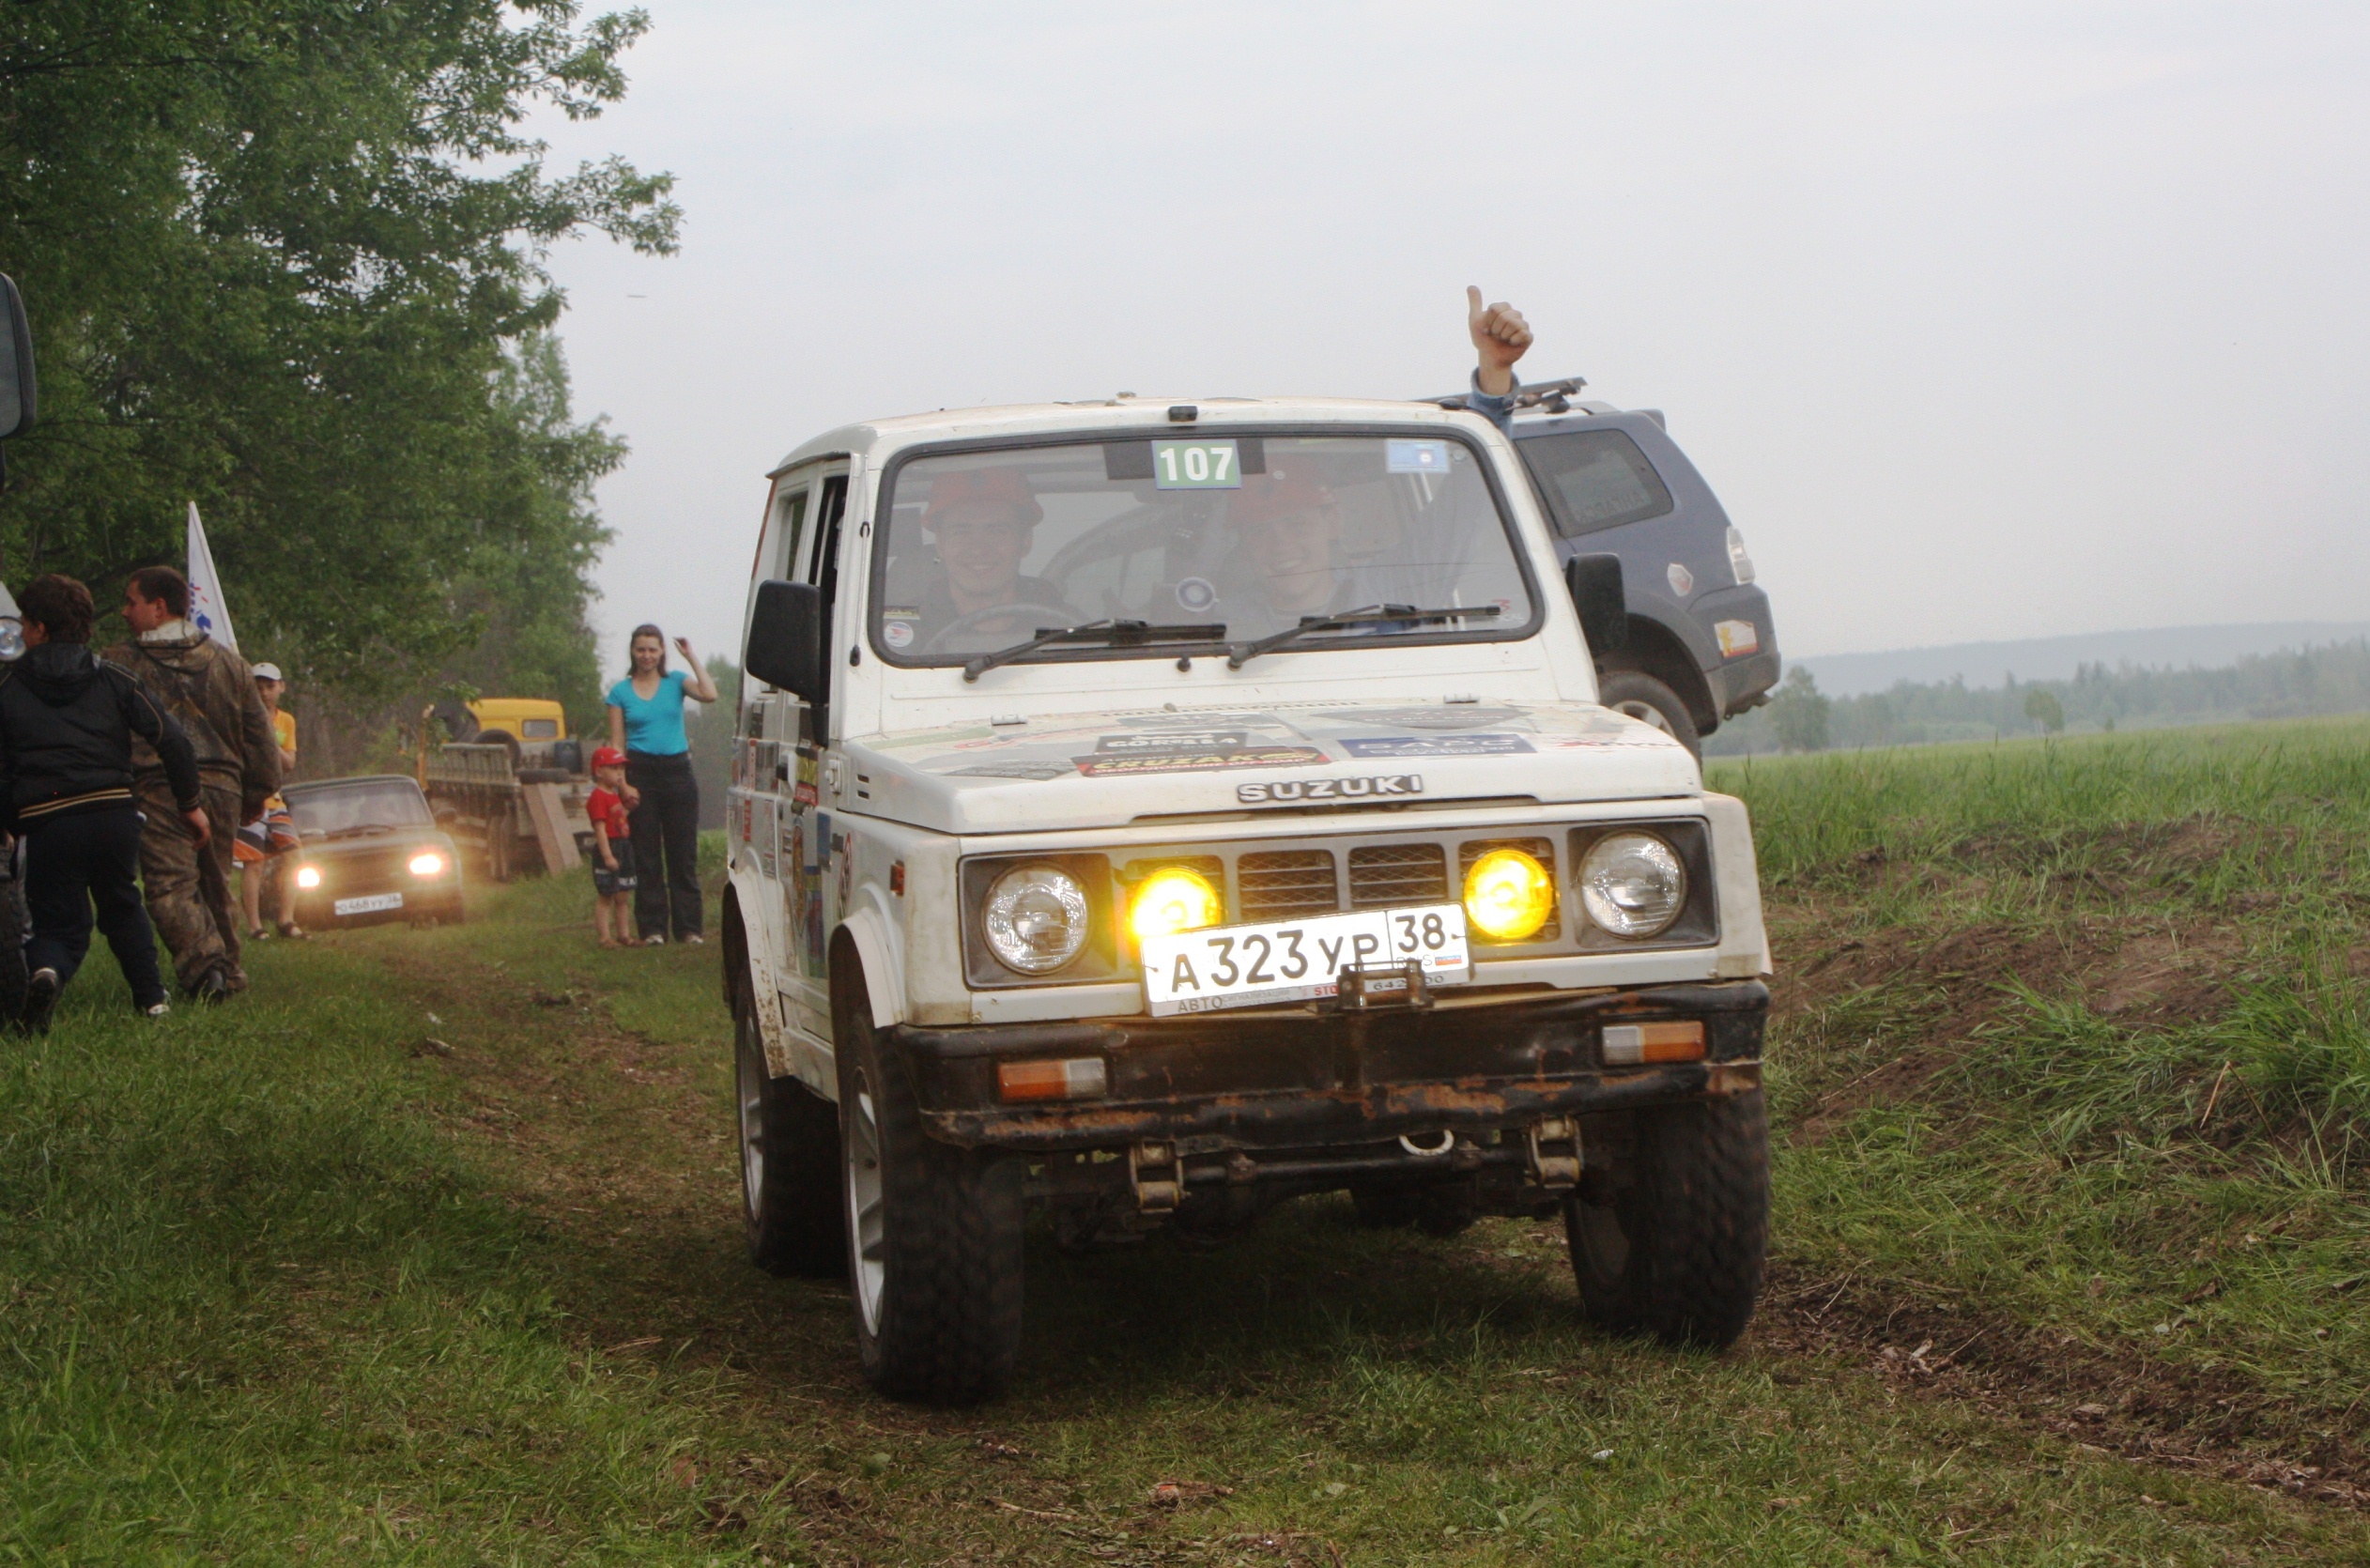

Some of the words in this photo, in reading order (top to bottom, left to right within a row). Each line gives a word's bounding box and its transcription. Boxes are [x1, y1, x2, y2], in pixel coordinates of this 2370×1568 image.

[1160, 447, 1233, 482] 107
[1238, 775, 1423, 803] SUZUKI
[1171, 929, 1379, 992] А323УР
[1394, 913, 1447, 953] 38
[1177, 996, 1223, 1013] АВТО
